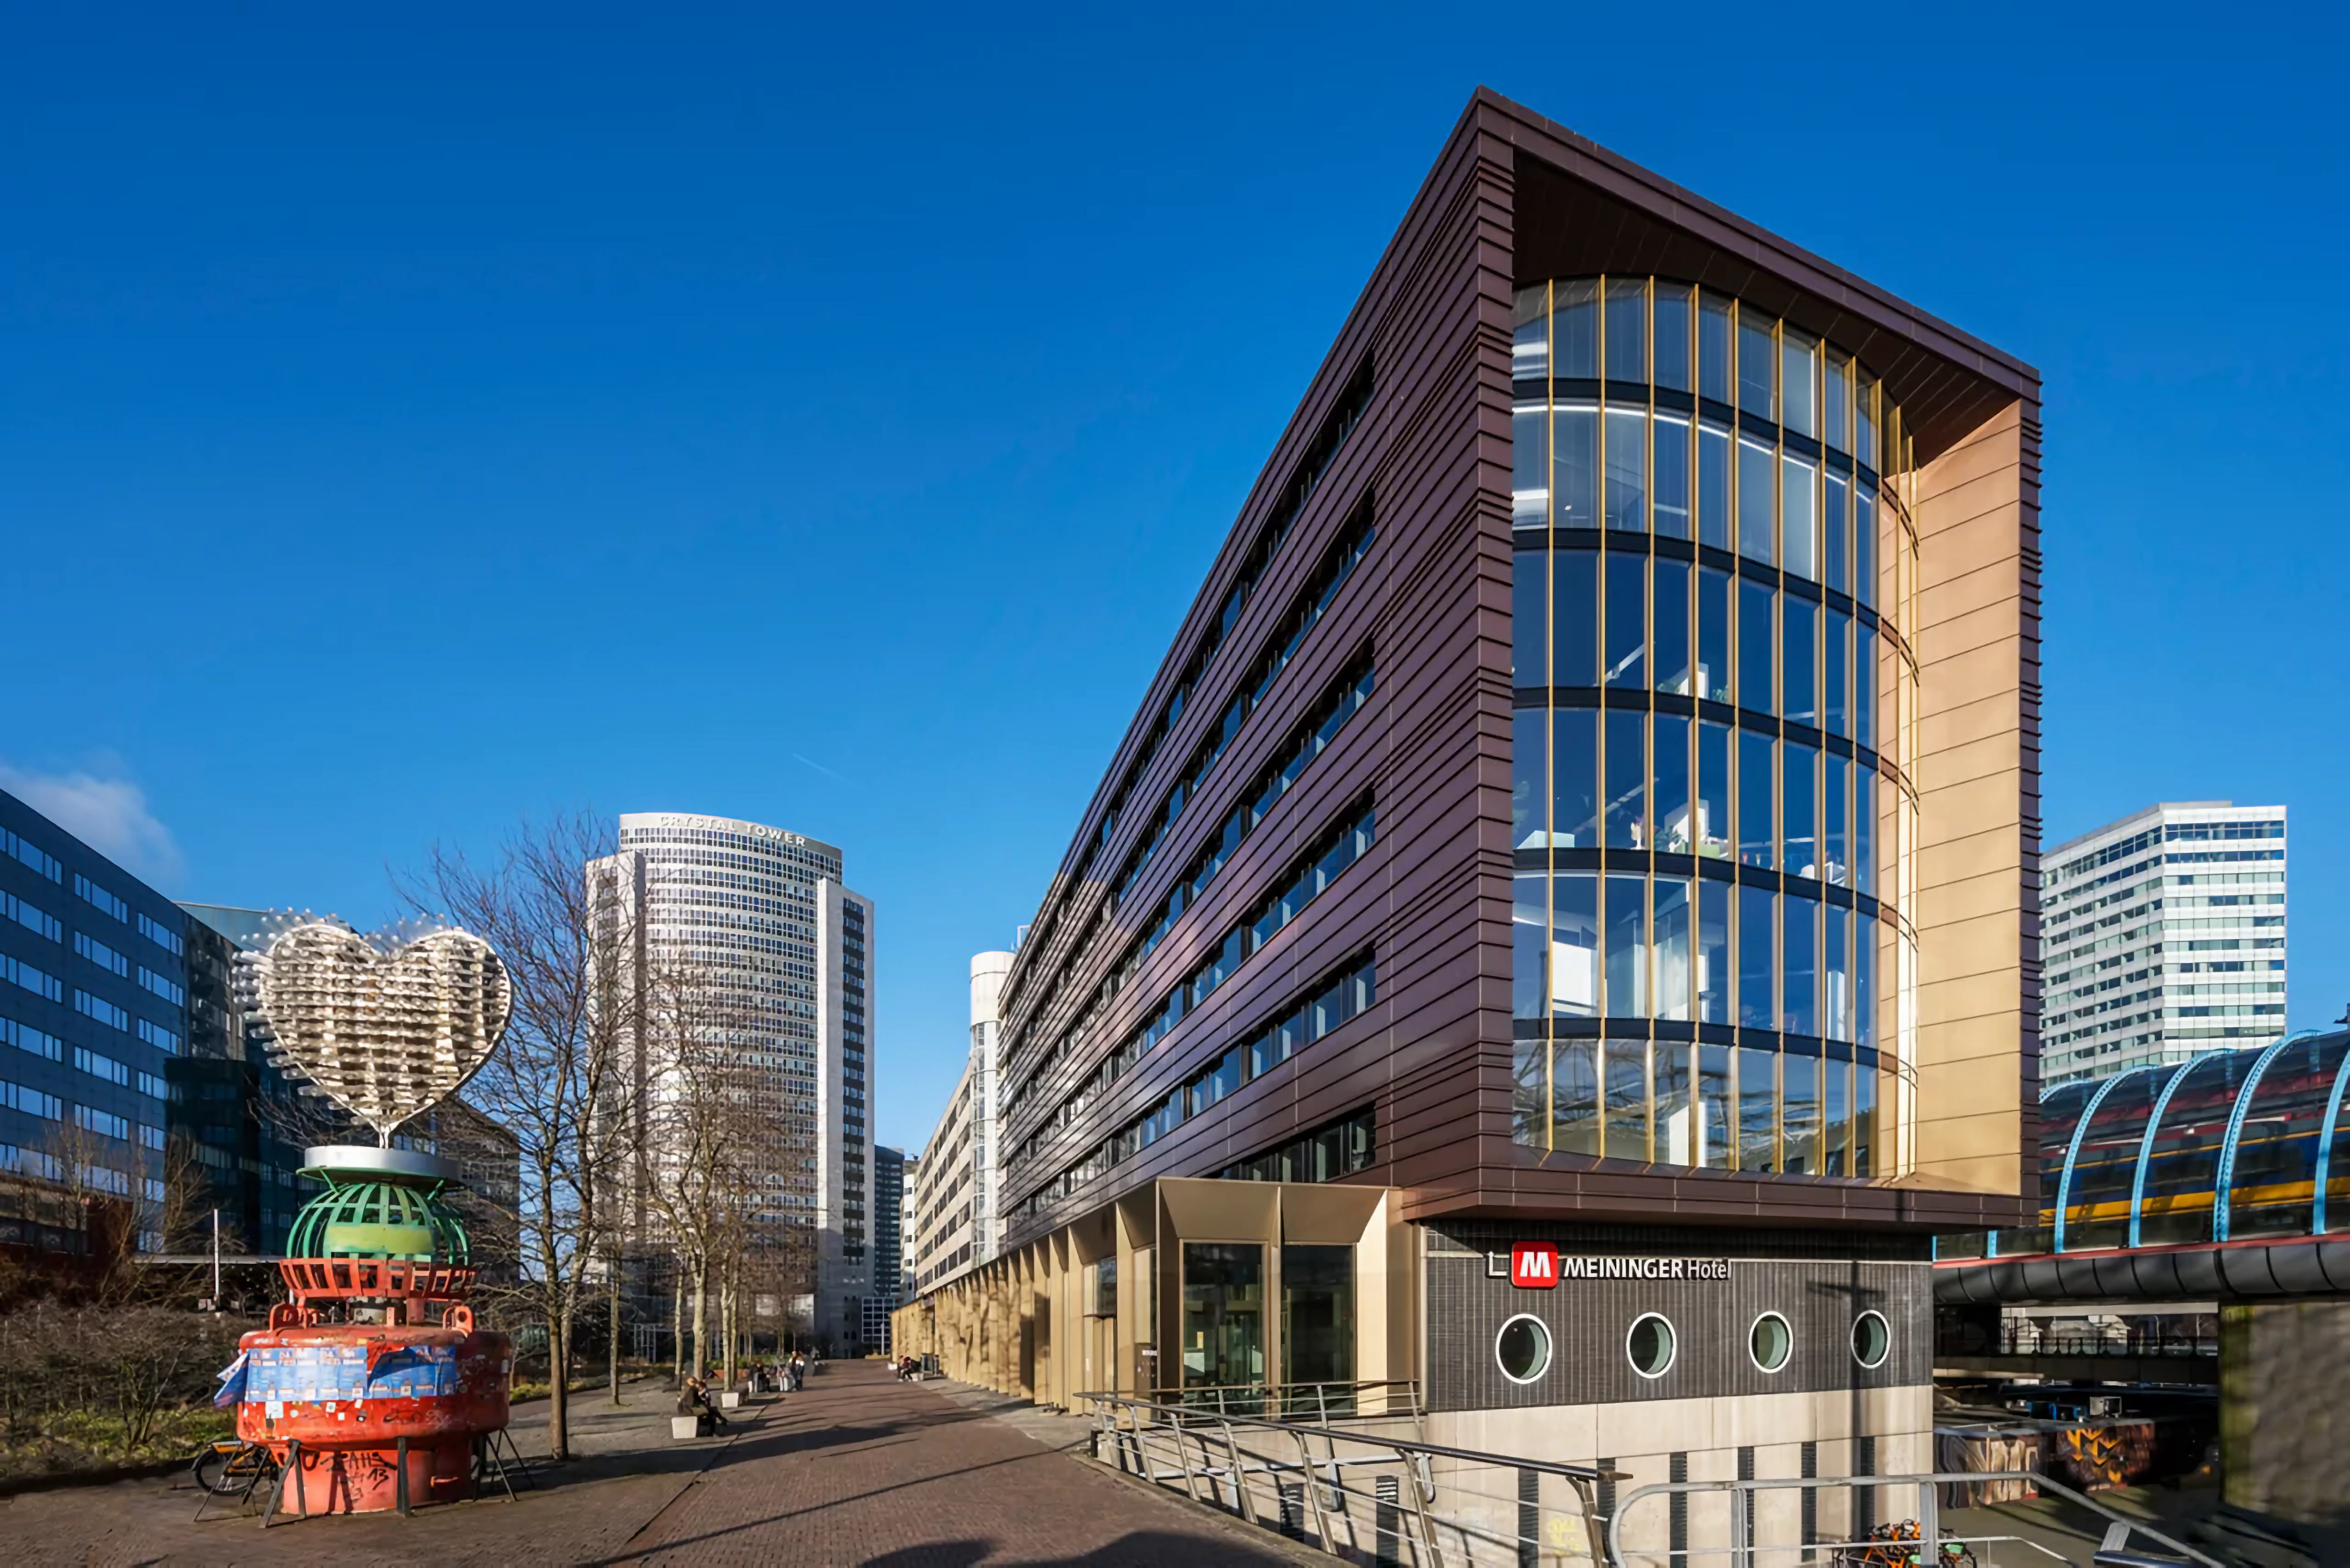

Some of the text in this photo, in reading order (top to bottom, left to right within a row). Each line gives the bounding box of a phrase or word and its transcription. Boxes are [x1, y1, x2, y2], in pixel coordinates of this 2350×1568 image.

[660, 816, 806, 847] CRYSTAL TOWER
[1519, 1251, 1551, 1277] M
[1563, 1258, 1731, 1278] MEININGER Hotel
